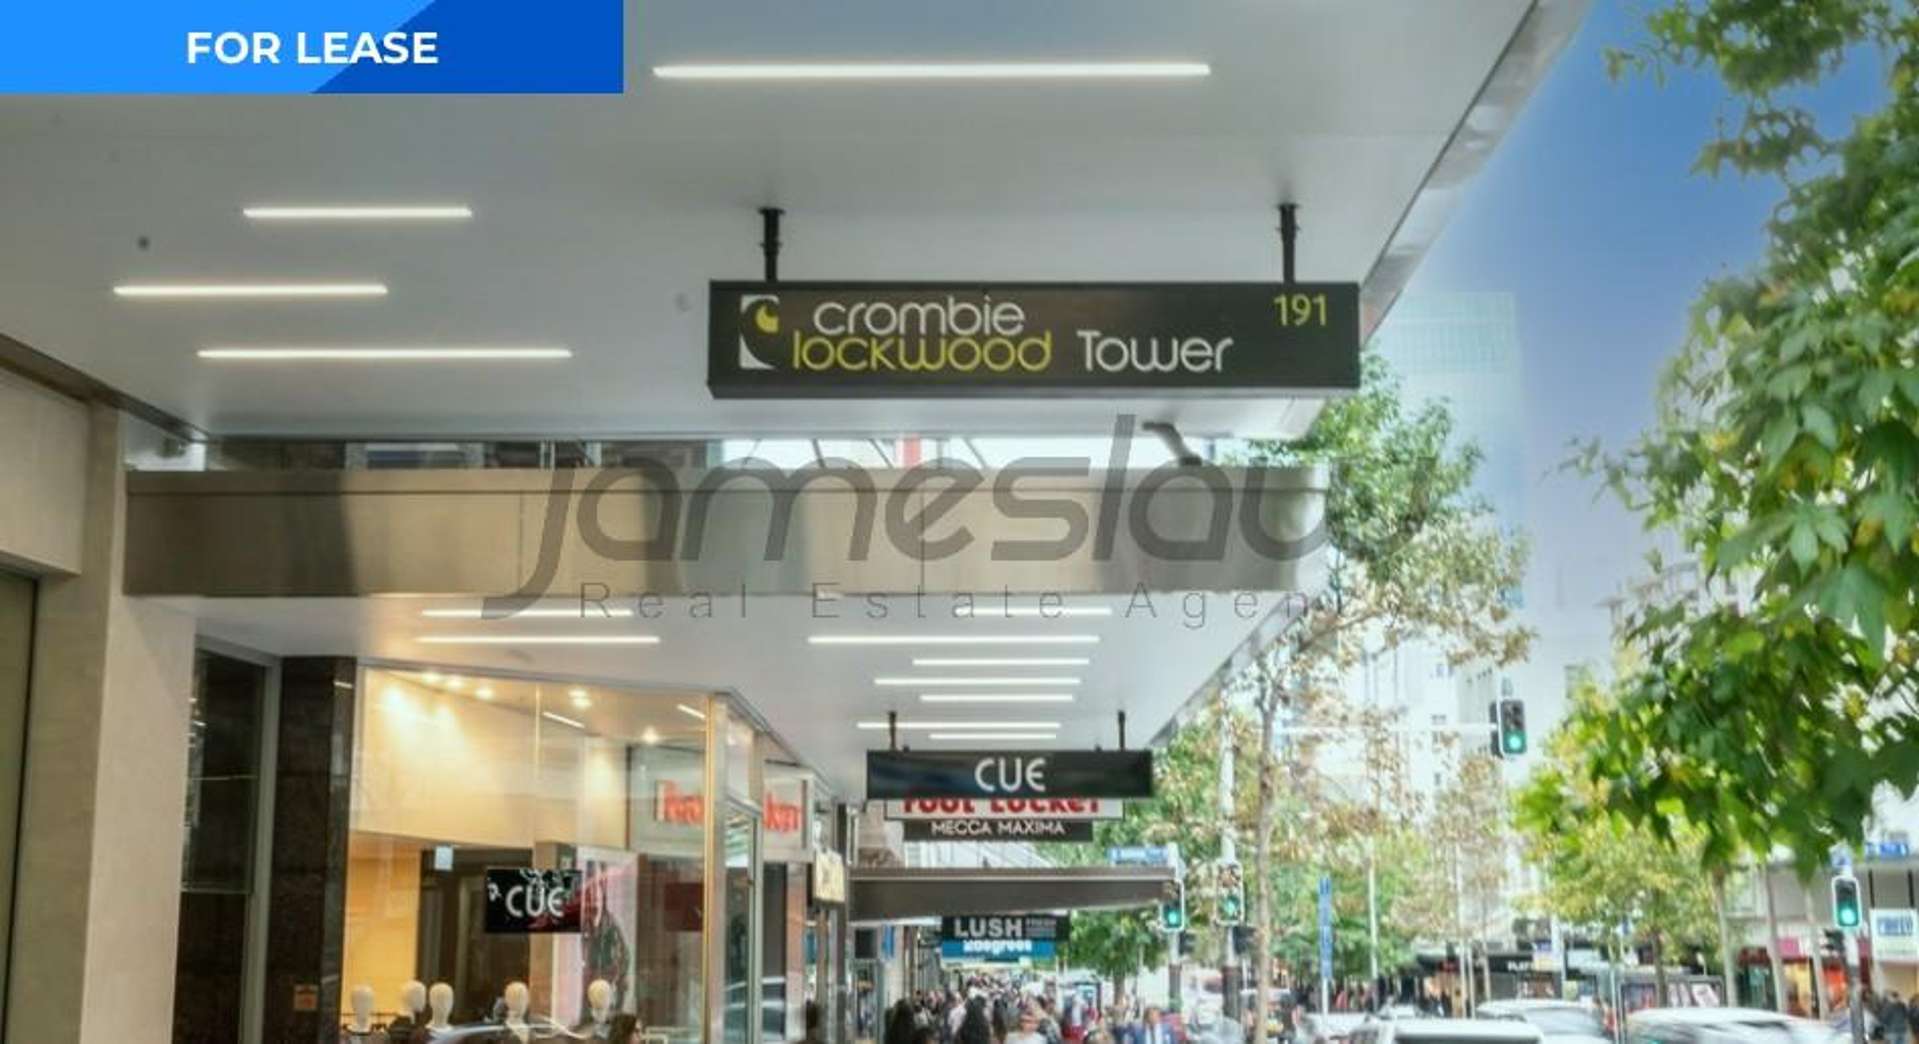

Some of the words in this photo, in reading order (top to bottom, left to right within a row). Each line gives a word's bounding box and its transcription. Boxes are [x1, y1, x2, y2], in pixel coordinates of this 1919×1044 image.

[812, 295, 1025, 337] crombie
[1273, 295, 1328, 328] 191
[792, 329, 1053, 373] lockwood
[1076, 329, 1235, 373] Tower
[974, 757, 1047, 792] CUE
[931, 820, 992, 836] MECCA
[997, 820, 1066, 836] MAXIMA
[505, 884, 565, 918] CUE
[954, 917, 1023, 938] LUSH
